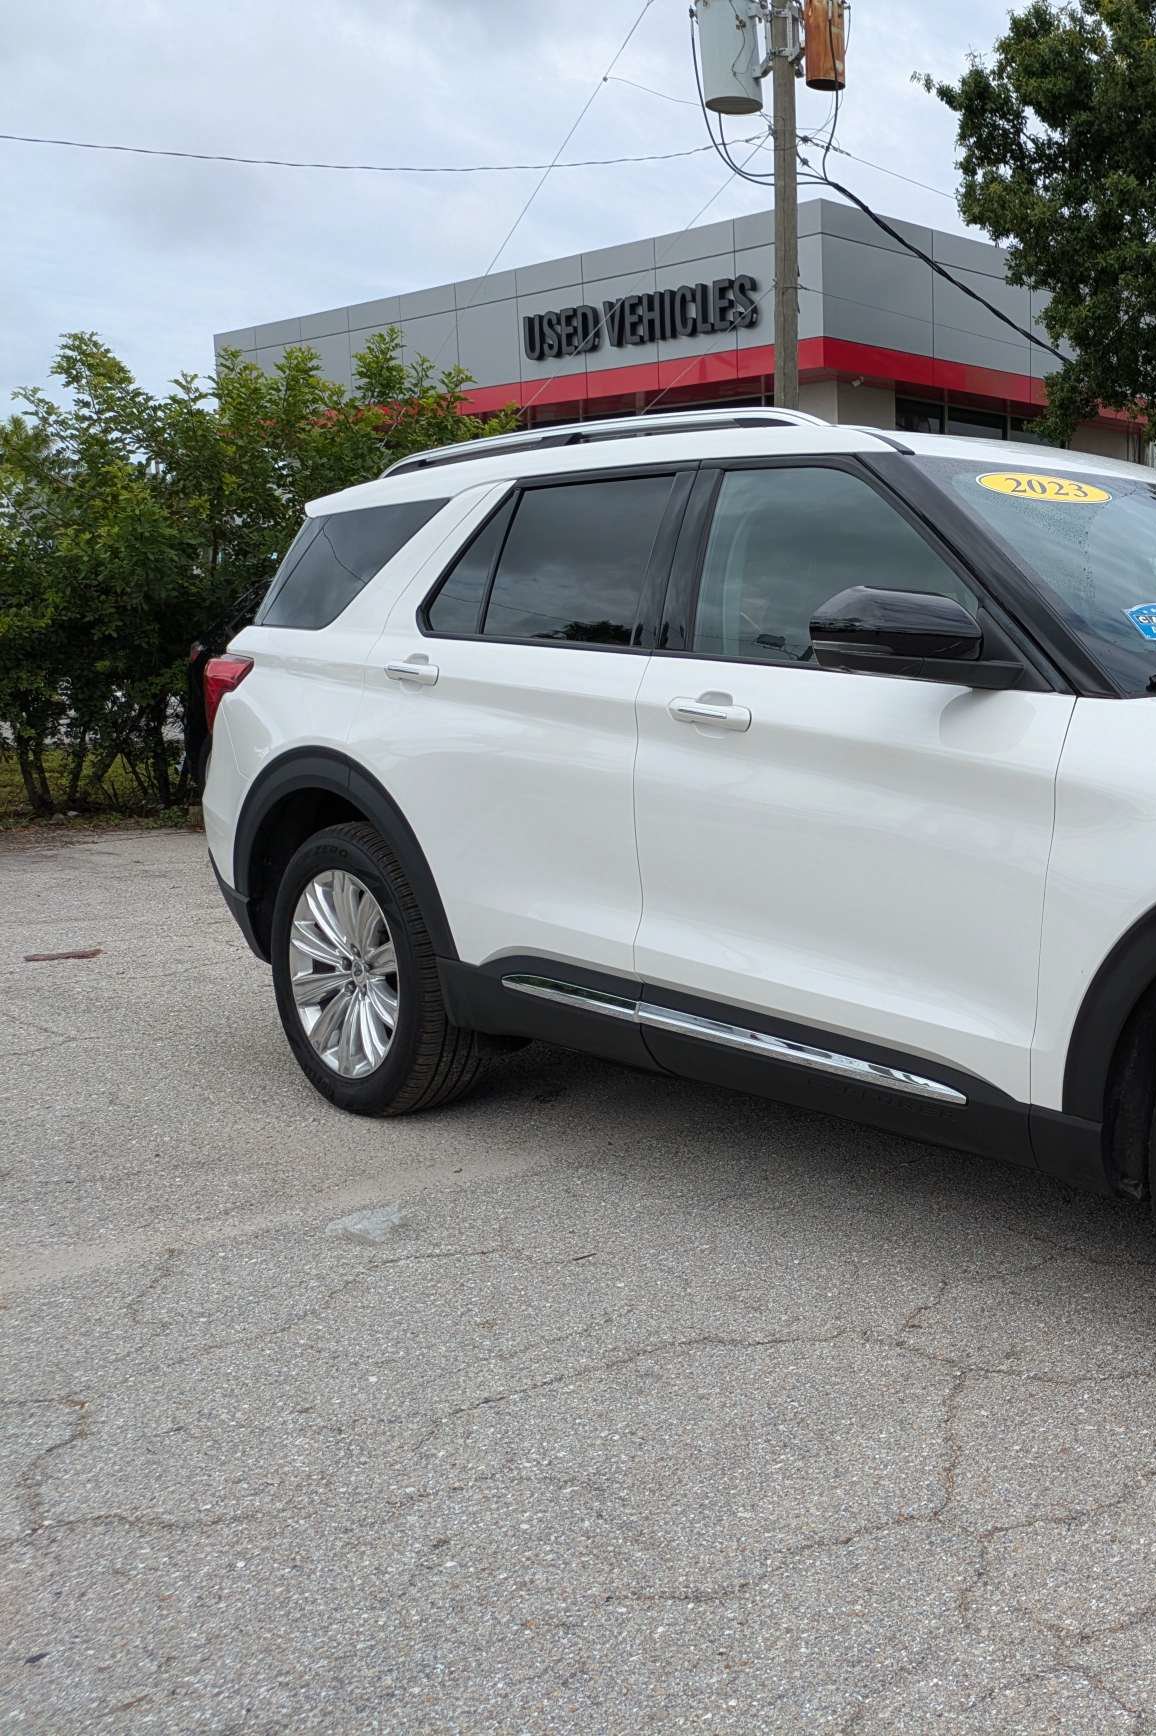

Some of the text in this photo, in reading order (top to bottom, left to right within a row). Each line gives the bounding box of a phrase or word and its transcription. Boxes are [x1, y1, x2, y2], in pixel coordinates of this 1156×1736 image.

[523, 274, 760, 361] USED VEHICLES
[1004, 477, 1089, 498] 2023
